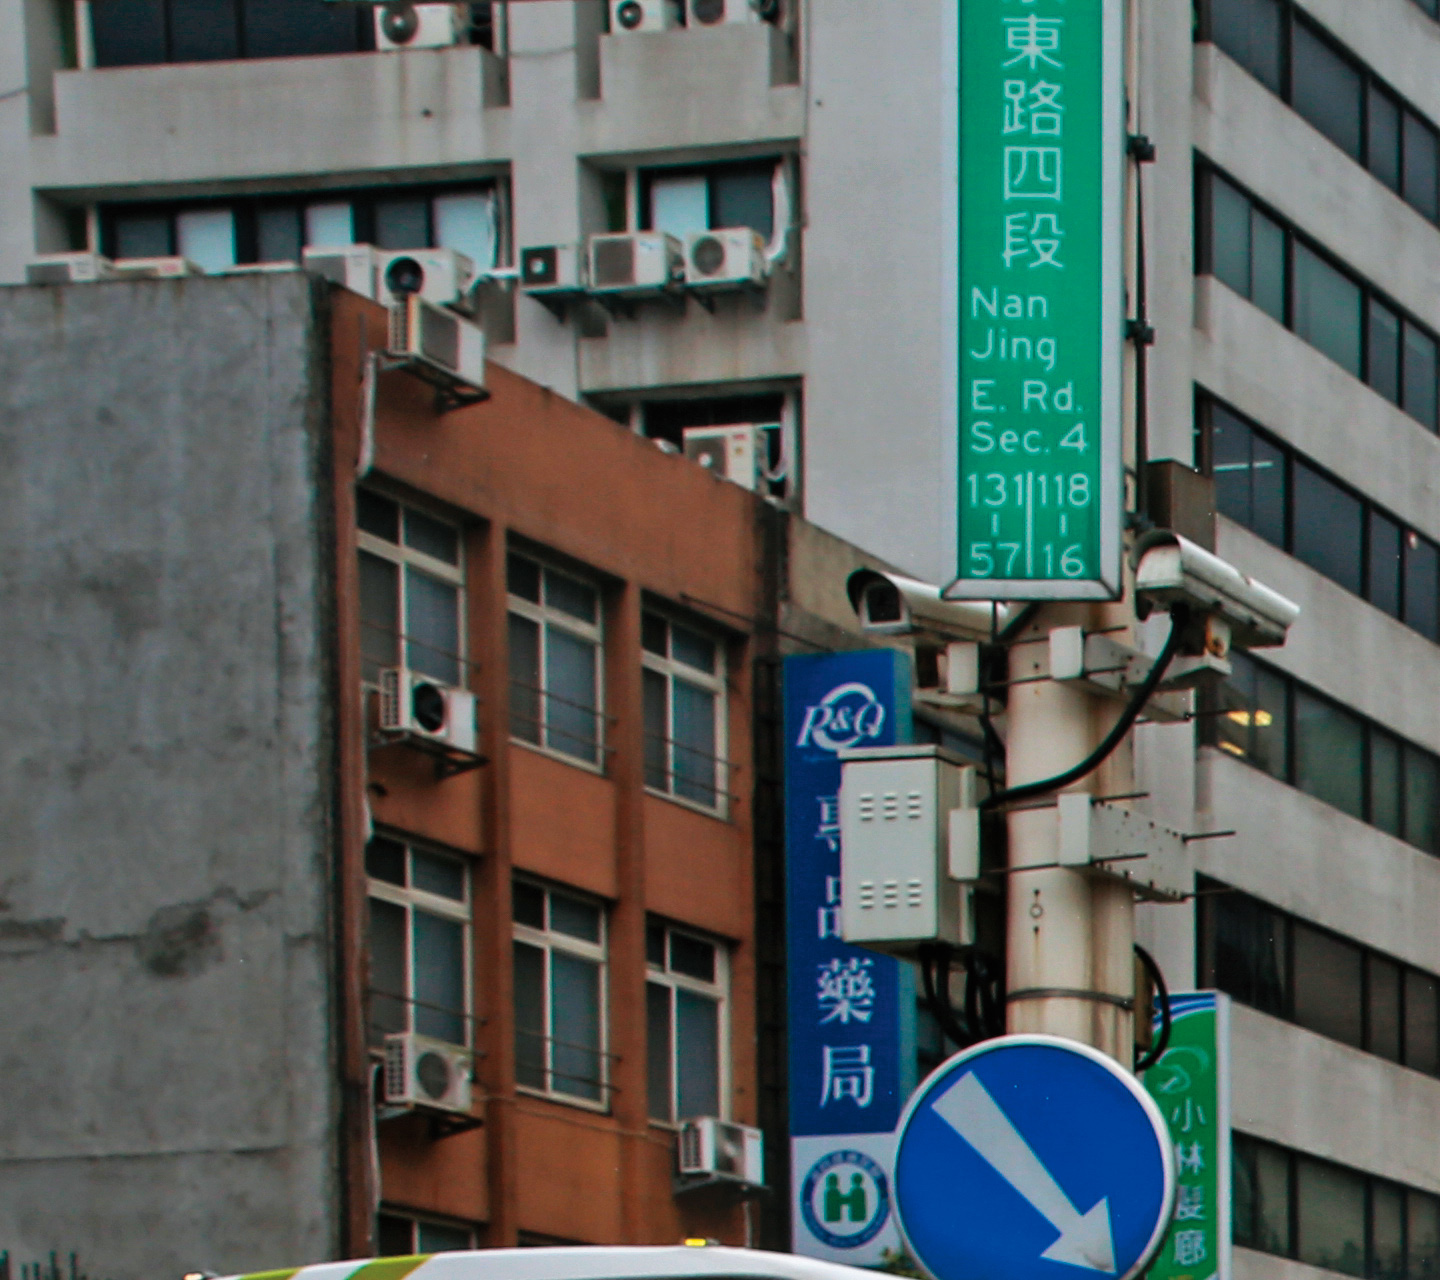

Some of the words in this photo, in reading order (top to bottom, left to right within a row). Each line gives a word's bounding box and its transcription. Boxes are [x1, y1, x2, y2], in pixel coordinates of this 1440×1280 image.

[1002, 0, 1064, 269] 東路四段
[970, 287, 1048, 319] Nan
[970, 333, 1057, 372] Jing
[971, 380, 1006, 412] E.
[1022, 380, 1084, 412] Rd.
[970, 422, 1050, 454] Sec.
[1058, 423, 1088, 453] 4
[967, 474, 1023, 507] 131
[1038, 474, 1090, 507] 118
[970, 542, 1020, 577] 57
[1044, 542, 1086, 577] 16
